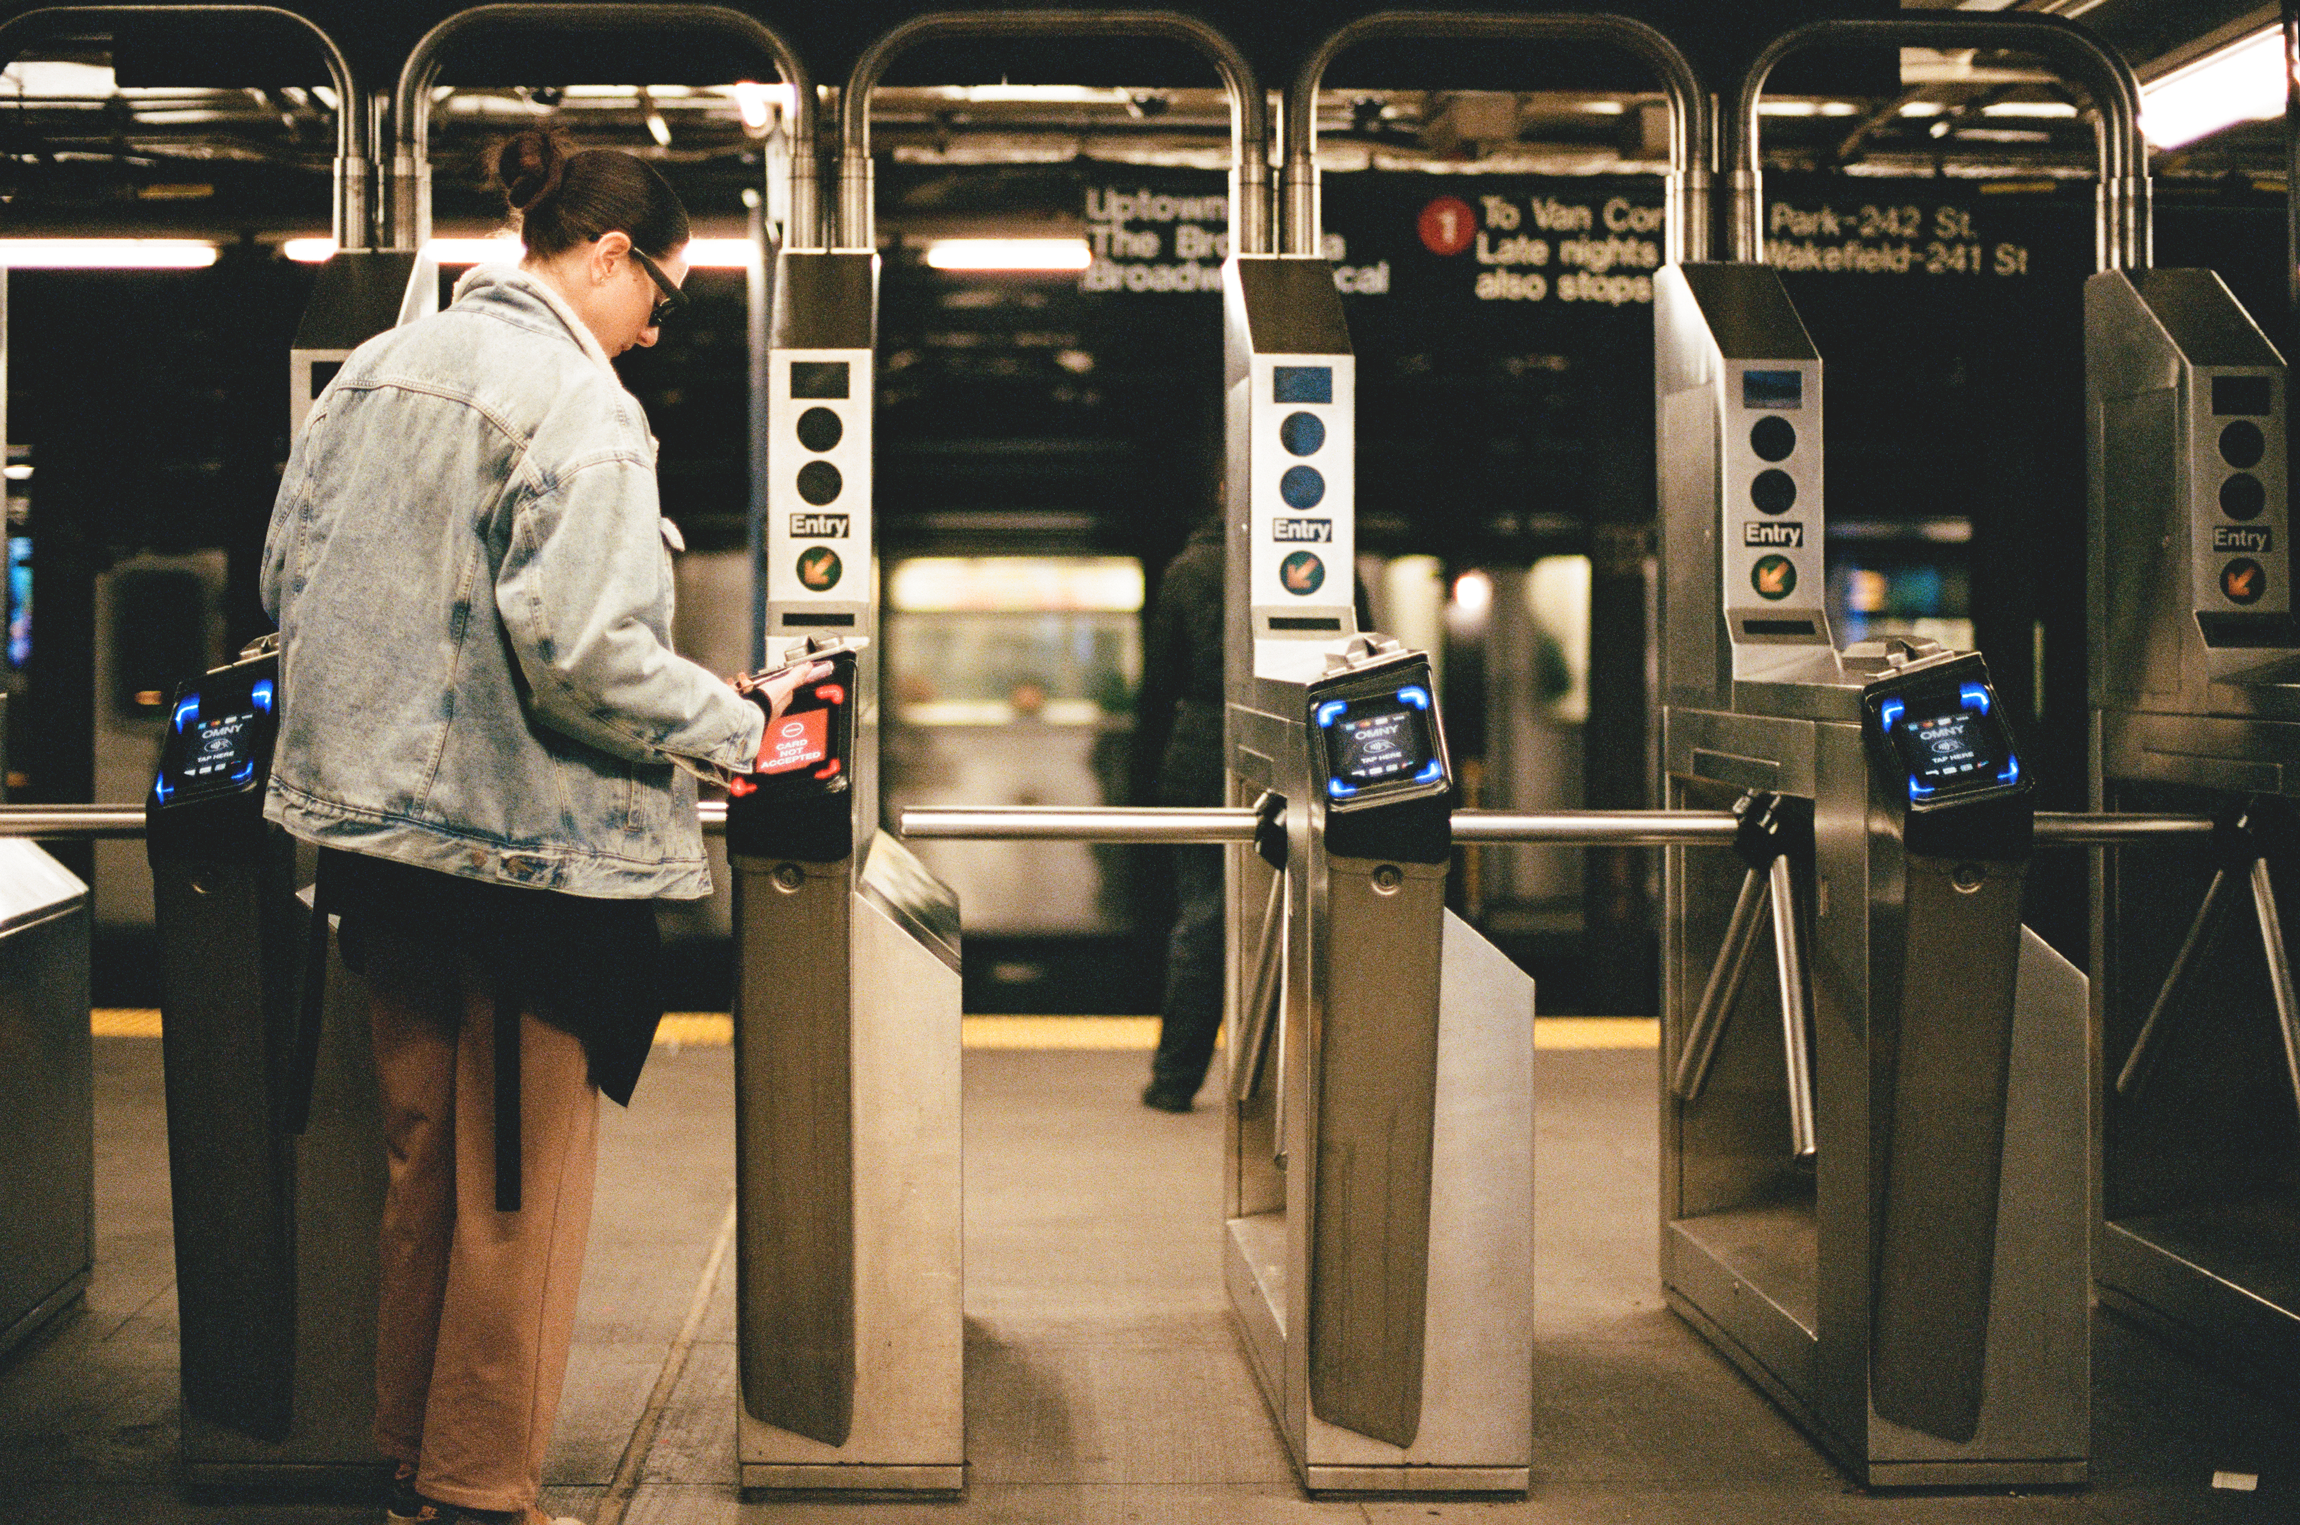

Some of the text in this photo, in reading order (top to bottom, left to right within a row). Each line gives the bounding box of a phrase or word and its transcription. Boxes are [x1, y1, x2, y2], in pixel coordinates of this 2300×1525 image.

[1086, 188, 1229, 229] Uptown
[1480, 196, 1521, 231] To
[1532, 196, 1593, 231] Van
[1603, 196, 1664, 232] Cor
[1770, 202, 1921, 238] Park-242
[1440, 210, 1457, 244] 1
[1088, 224, 1229, 258] The Bro
[1476, 231, 1549, 266] Late
[1559, 234, 1659, 273] nights
[1994, 242, 2028, 275] St
[1083, 259, 1390, 294] Broadw cal
[1475, 267, 1651, 306] also stops
[792, 515, 848, 538] Entry
[1273, 519, 1330, 542] Entry
[1746, 523, 1800, 547] Entry
[2214, 528, 2267, 551] Entry
[202, 723, 243, 739] OMNY
[1355, 724, 1398, 740] OMNY
[1920, 725, 1964, 740] OMNY
[213, 750, 234, 760] HERE
[775, 739, 808, 751] CARD
[779, 747, 804, 758] NOT
[760, 751, 821, 769] ACCEPTED
[1361, 751, 1402, 764] TAP HERE
[1932, 751, 1974, 763] TAP HERE
